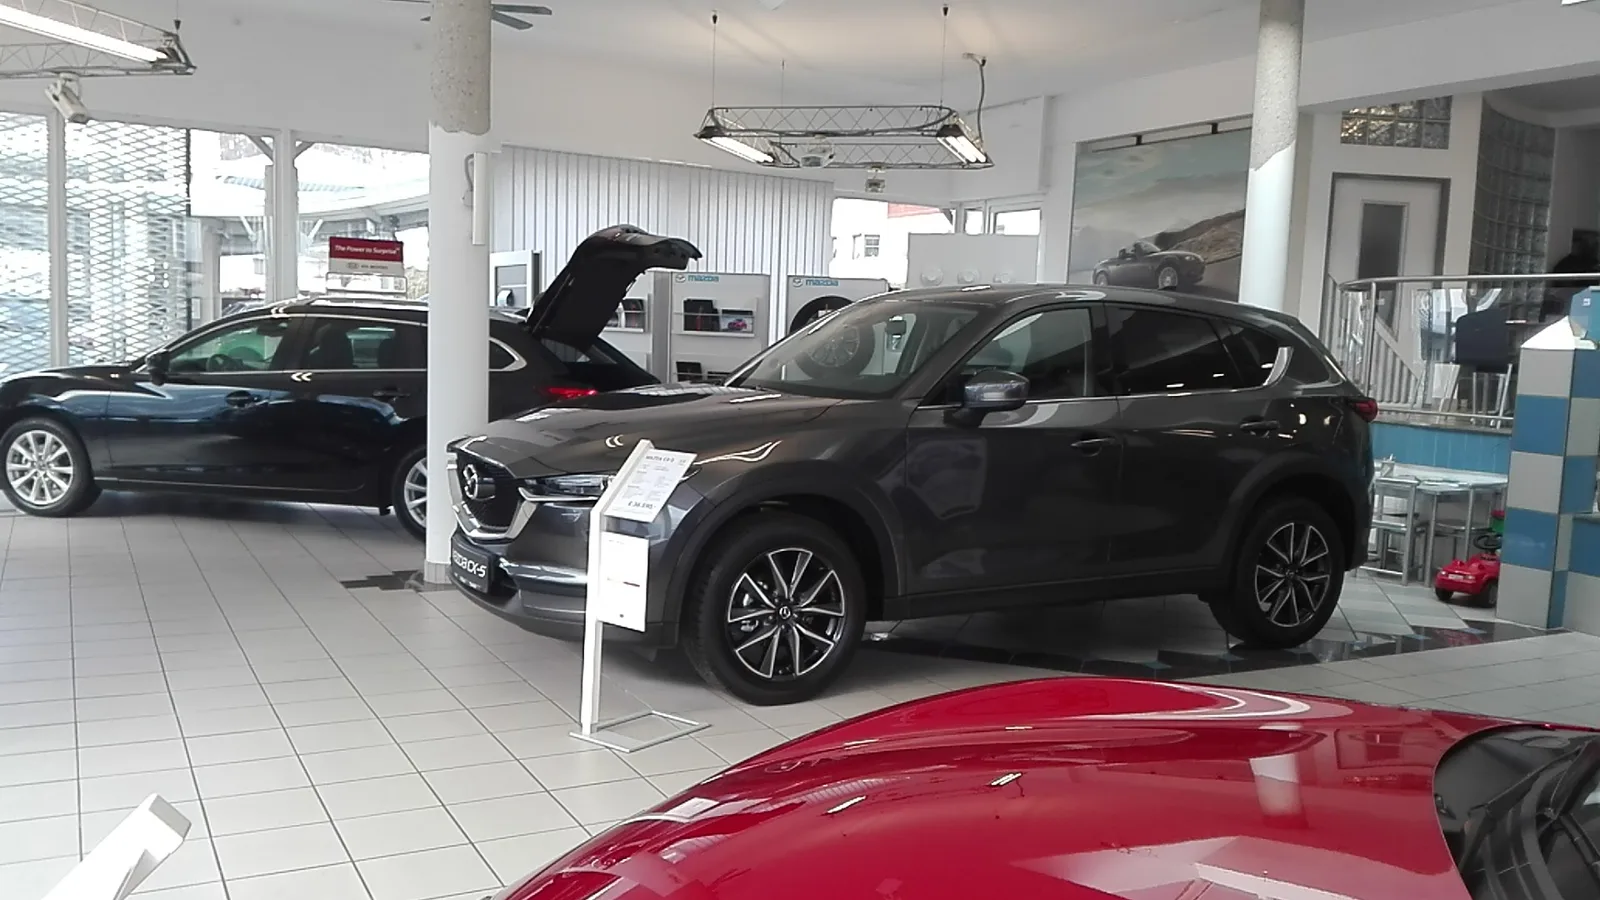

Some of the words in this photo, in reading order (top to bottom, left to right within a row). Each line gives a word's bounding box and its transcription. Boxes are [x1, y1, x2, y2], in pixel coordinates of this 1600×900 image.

[346, 245, 365, 253] Power
[687, 274, 720, 282] mazda
[805, 279, 839, 287] mazda
[467, 559, 487, 577] CX-5
